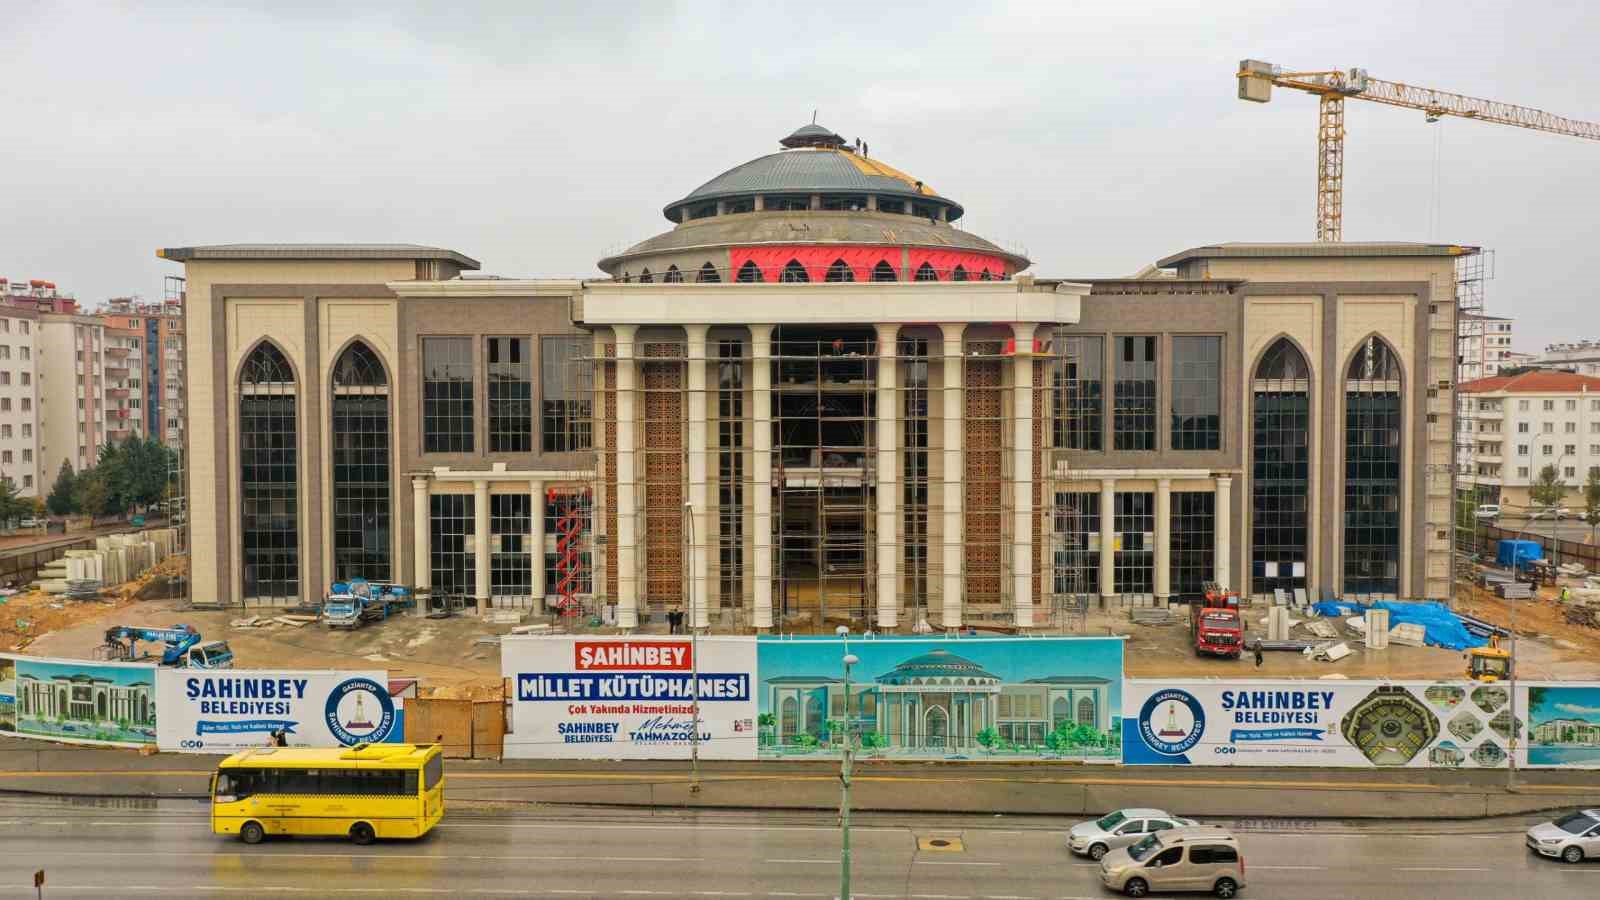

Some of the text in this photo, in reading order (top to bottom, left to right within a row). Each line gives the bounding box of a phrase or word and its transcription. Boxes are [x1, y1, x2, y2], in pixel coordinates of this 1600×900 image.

[580, 643, 686, 669] ŞAHİNBEY
[521, 675, 746, 698] MİLLET KÜTÜPHANESİ
[568, 704, 587, 716] Çok
[590, 704, 630, 715] Yakında
